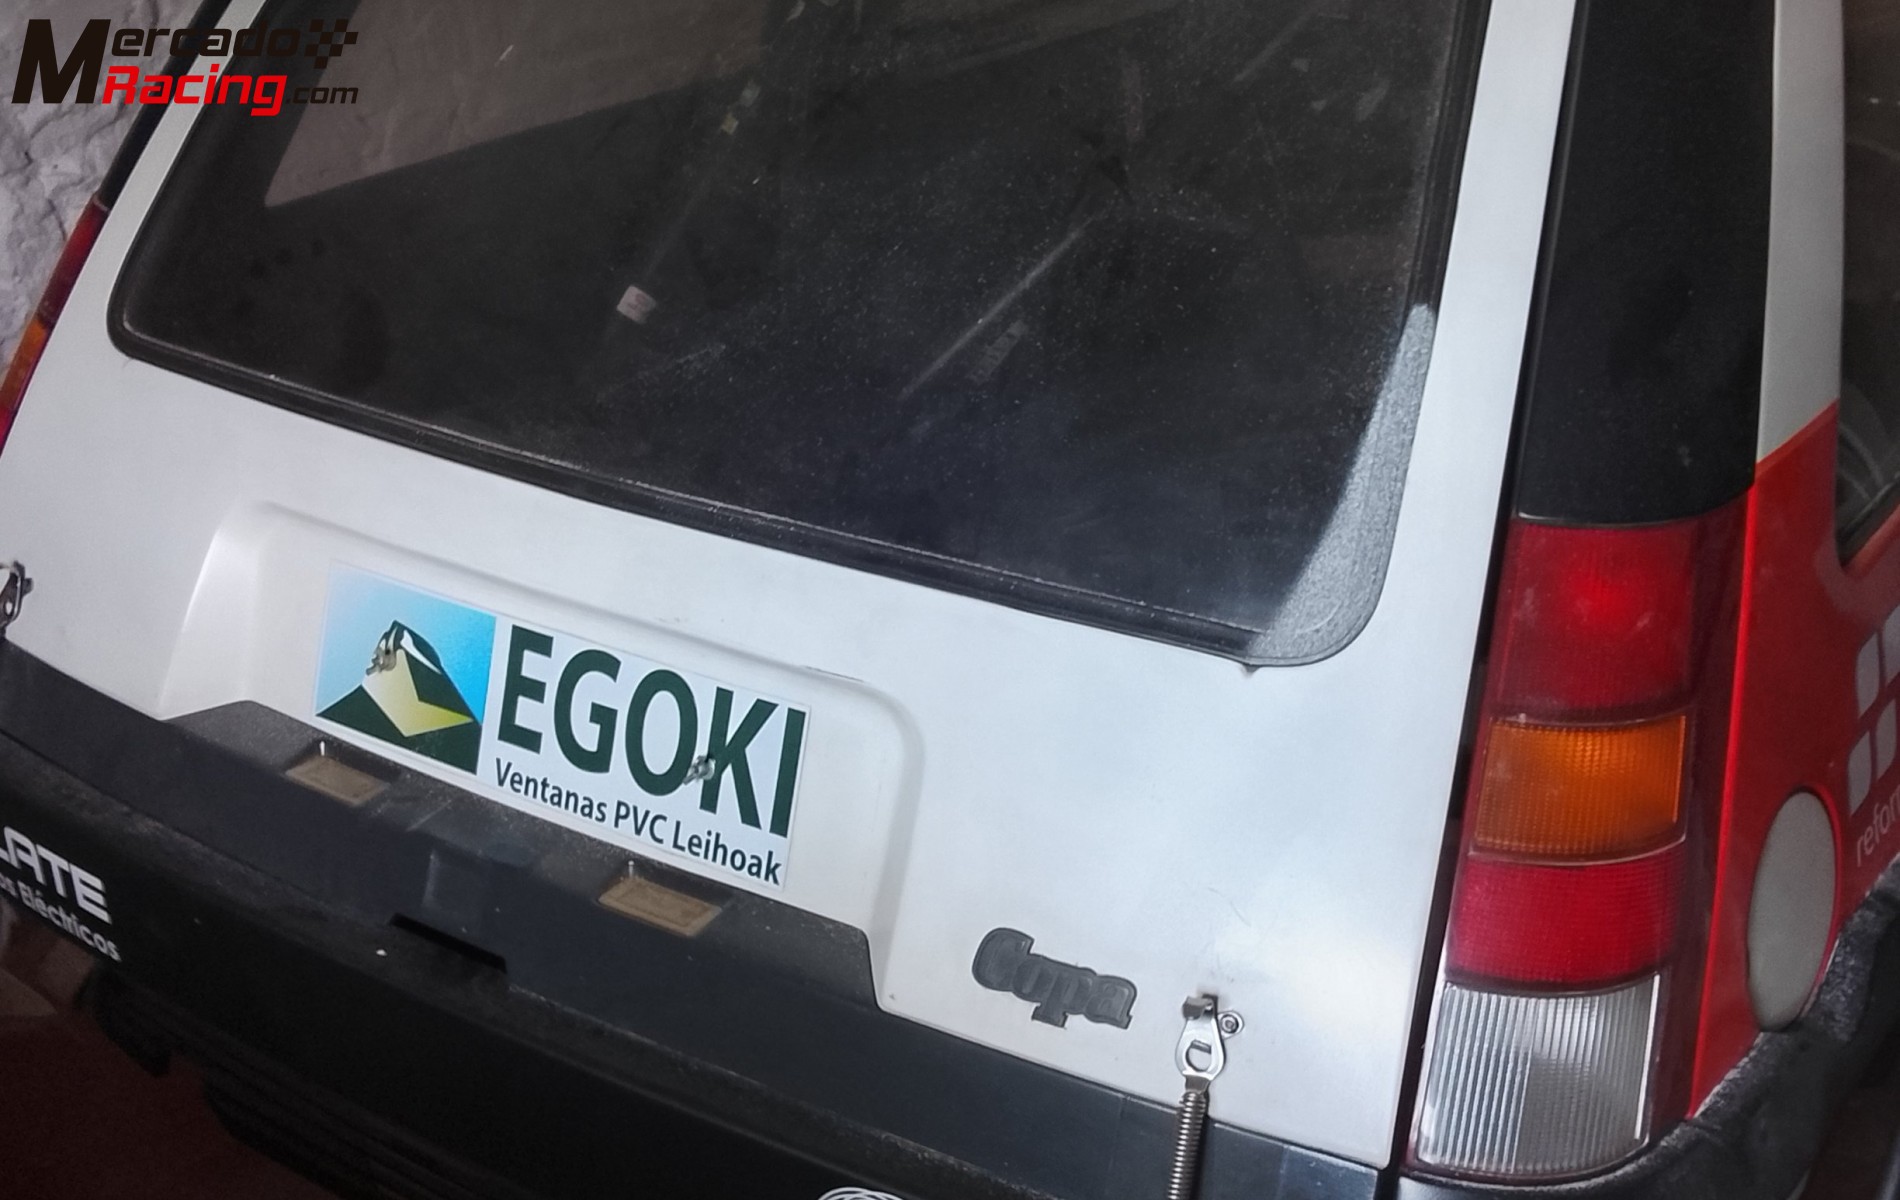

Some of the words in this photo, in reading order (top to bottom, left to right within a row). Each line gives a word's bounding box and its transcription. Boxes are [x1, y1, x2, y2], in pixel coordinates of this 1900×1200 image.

[497, 624, 807, 839] EGOKI
[495, 757, 607, 823] Ventanas
[614, 801, 668, 844] PVC
[672, 820, 782, 885] Leihoak
[1856, 783, 1900, 867] refor
[972, 927, 1137, 1030] Copa
